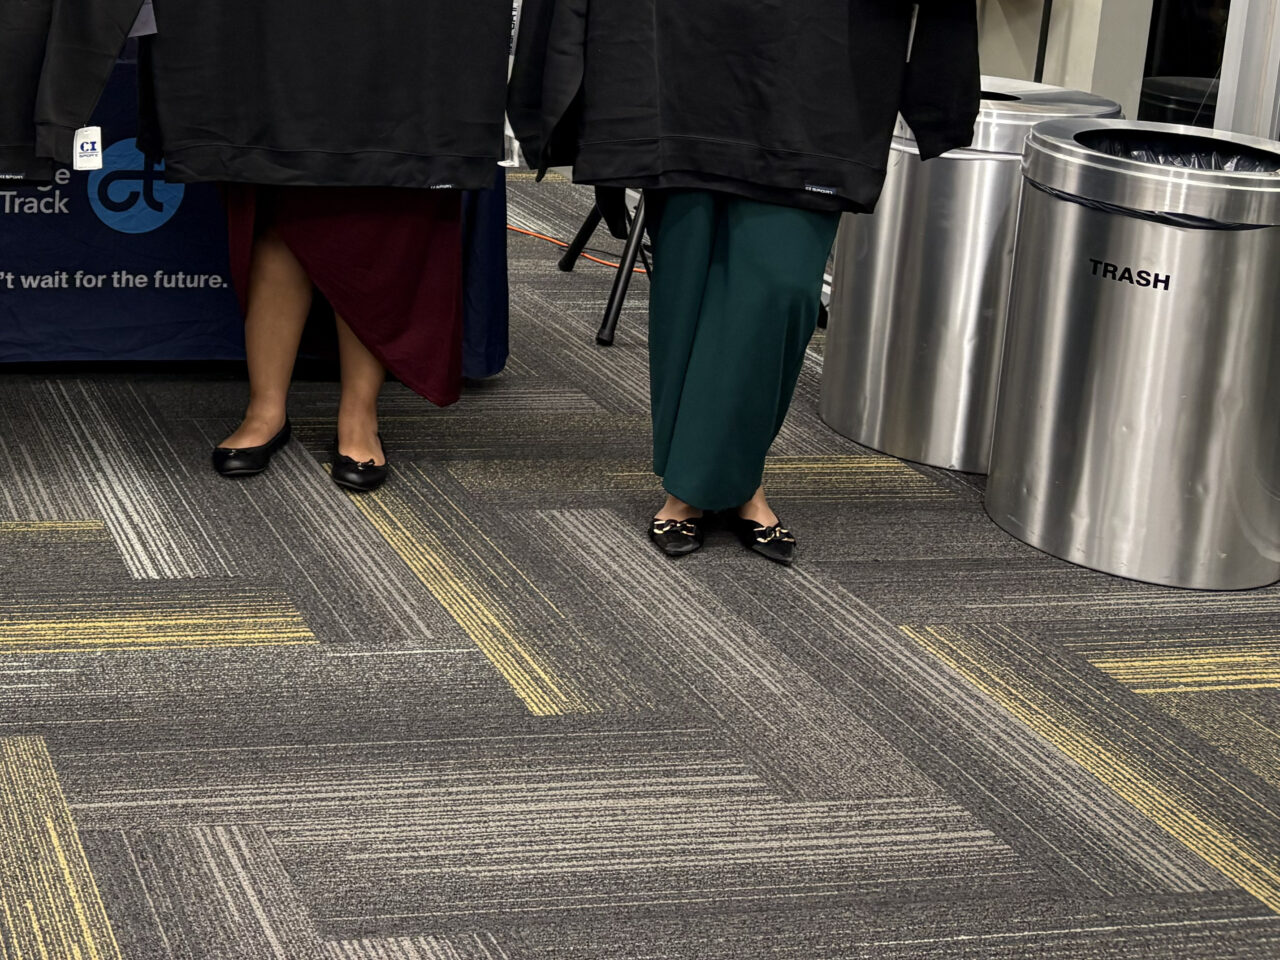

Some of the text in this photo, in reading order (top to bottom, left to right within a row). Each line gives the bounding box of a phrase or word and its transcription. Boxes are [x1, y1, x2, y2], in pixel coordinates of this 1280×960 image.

[80, 141, 97, 152] CI
[0, 190, 70, 214] Track
[20, 270, 69, 288] wait
[74, 270, 106, 288] for
[111, 270, 148, 288] the
[154, 270, 228, 288] future.
[1089, 258, 1171, 291] TRASH
